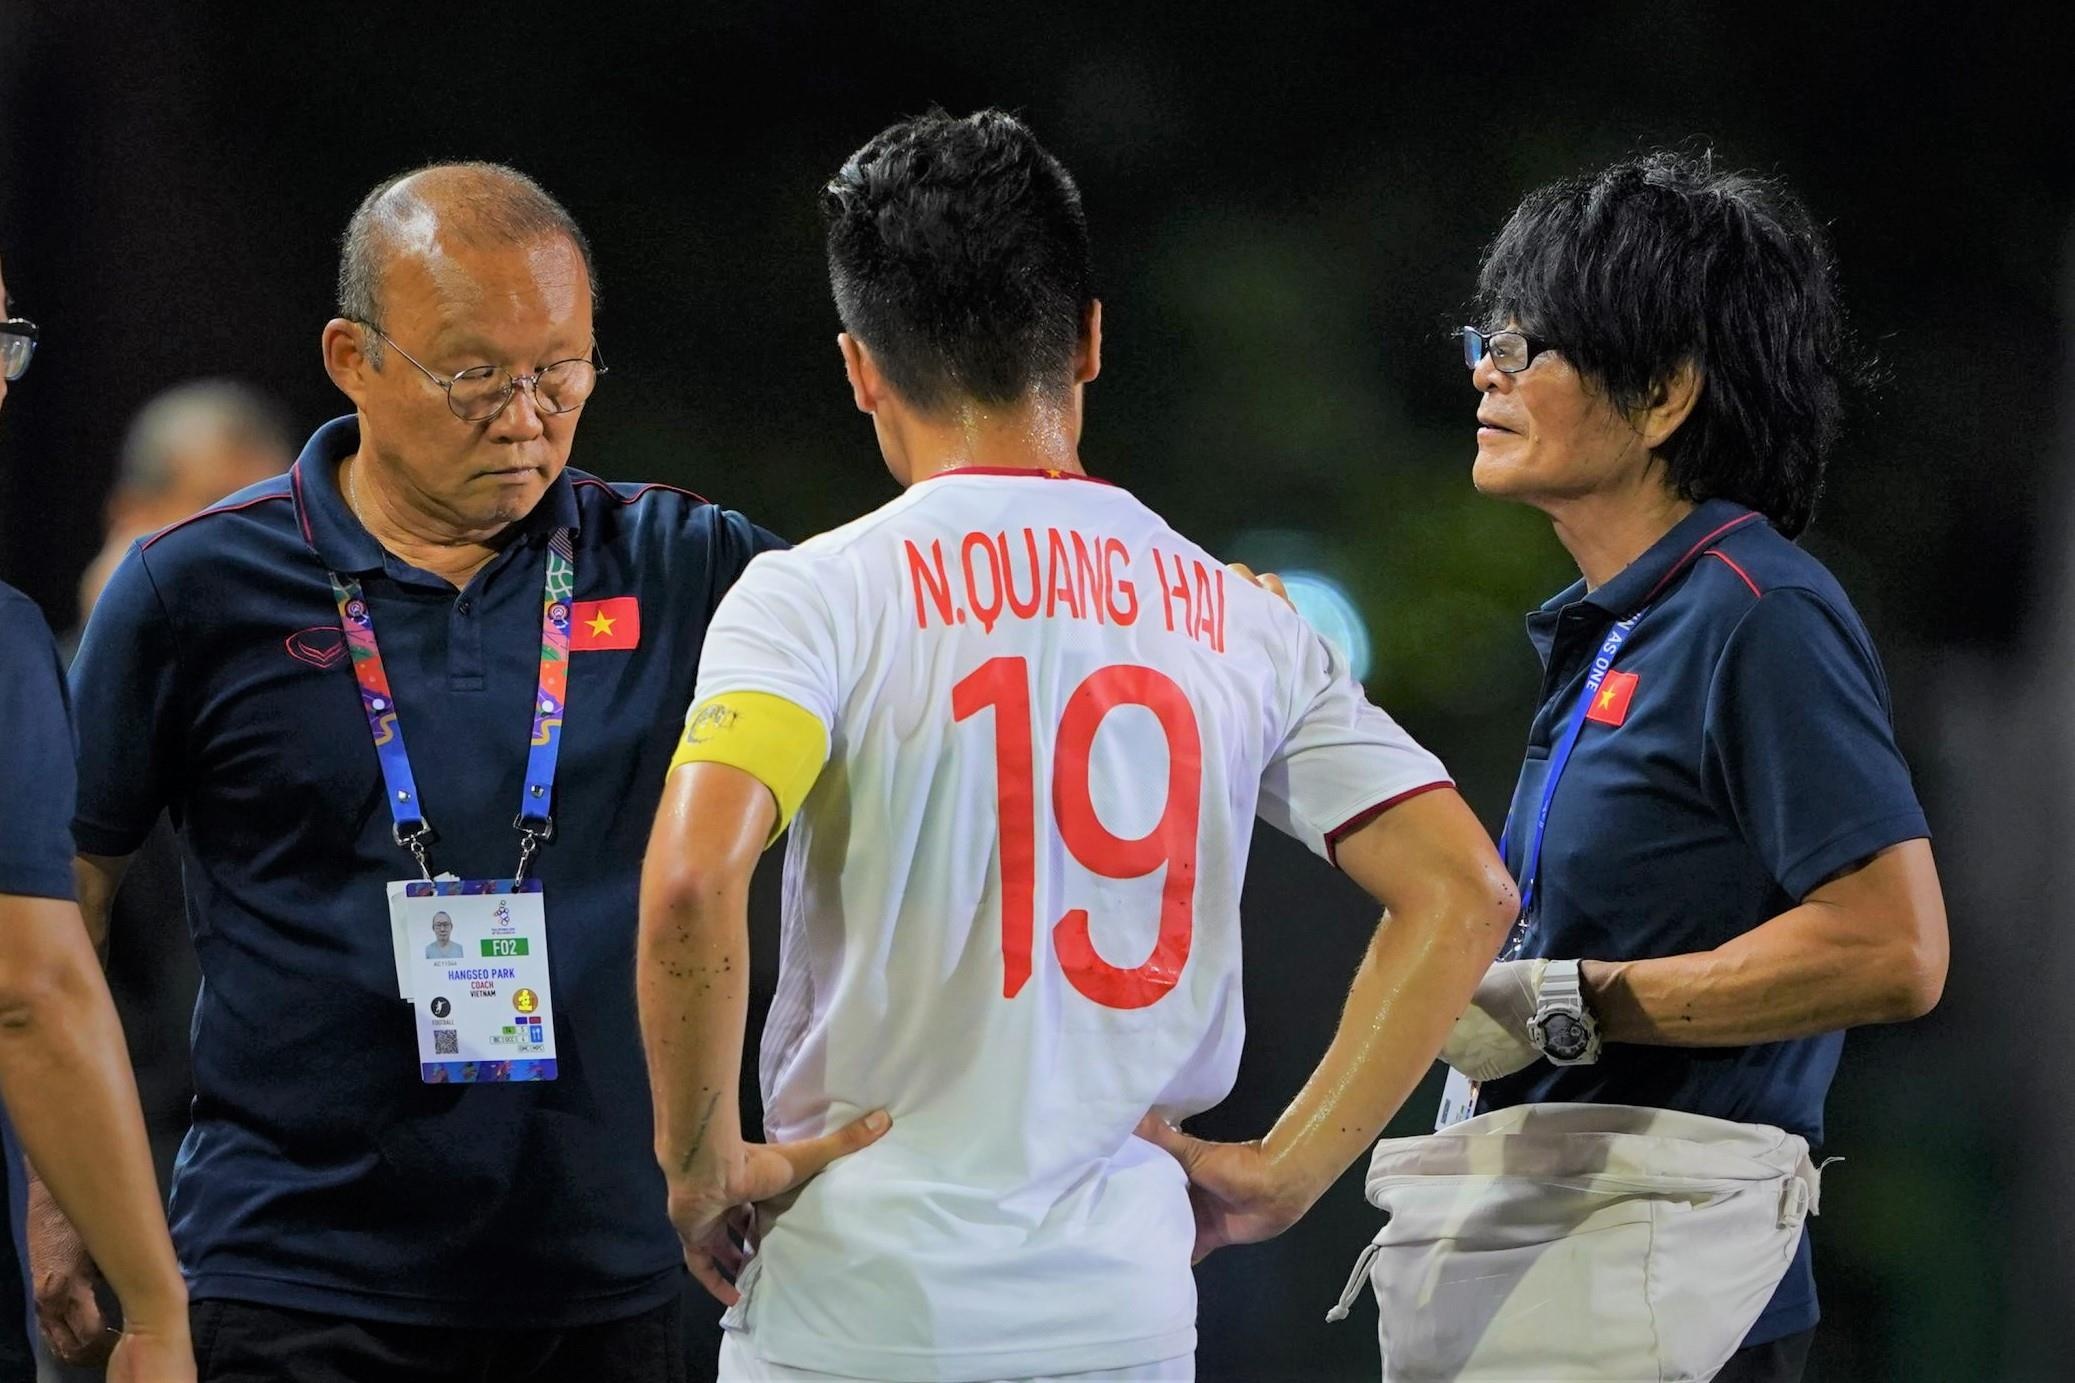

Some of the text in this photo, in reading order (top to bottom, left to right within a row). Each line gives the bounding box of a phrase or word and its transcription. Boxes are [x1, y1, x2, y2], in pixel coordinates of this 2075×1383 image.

[904, 528, 1225, 653] N.QUANG HAI
[1586, 631, 1622, 692] AS ONE
[951, 656, 1202, 1010] 19
[492, 939, 518, 956] F02
[448, 967, 515, 980] HANGSEO PARK
[470, 989, 496, 998] VIETNAM
[471, 981, 494, 989] COACH
